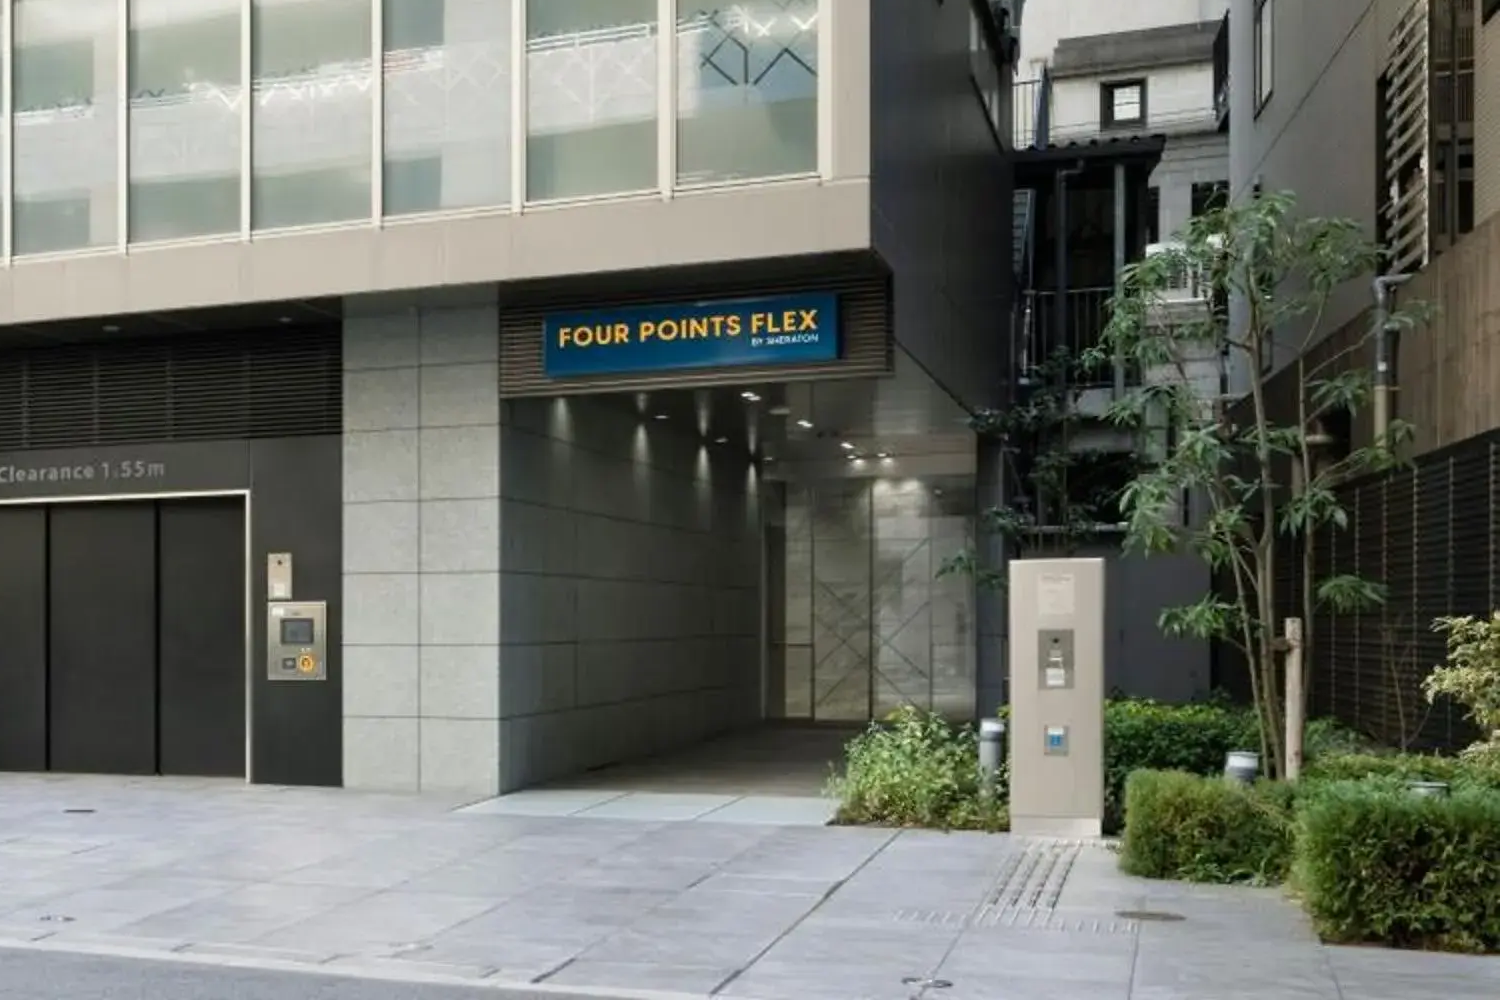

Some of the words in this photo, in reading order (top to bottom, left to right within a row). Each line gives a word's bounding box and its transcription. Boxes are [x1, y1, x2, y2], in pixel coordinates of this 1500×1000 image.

[559, 324, 629, 348] FOUR
[640, 314, 741, 343] POINTS
[751, 309, 818, 334] FLEX
[101, 461, 164, 480] 1.55m
